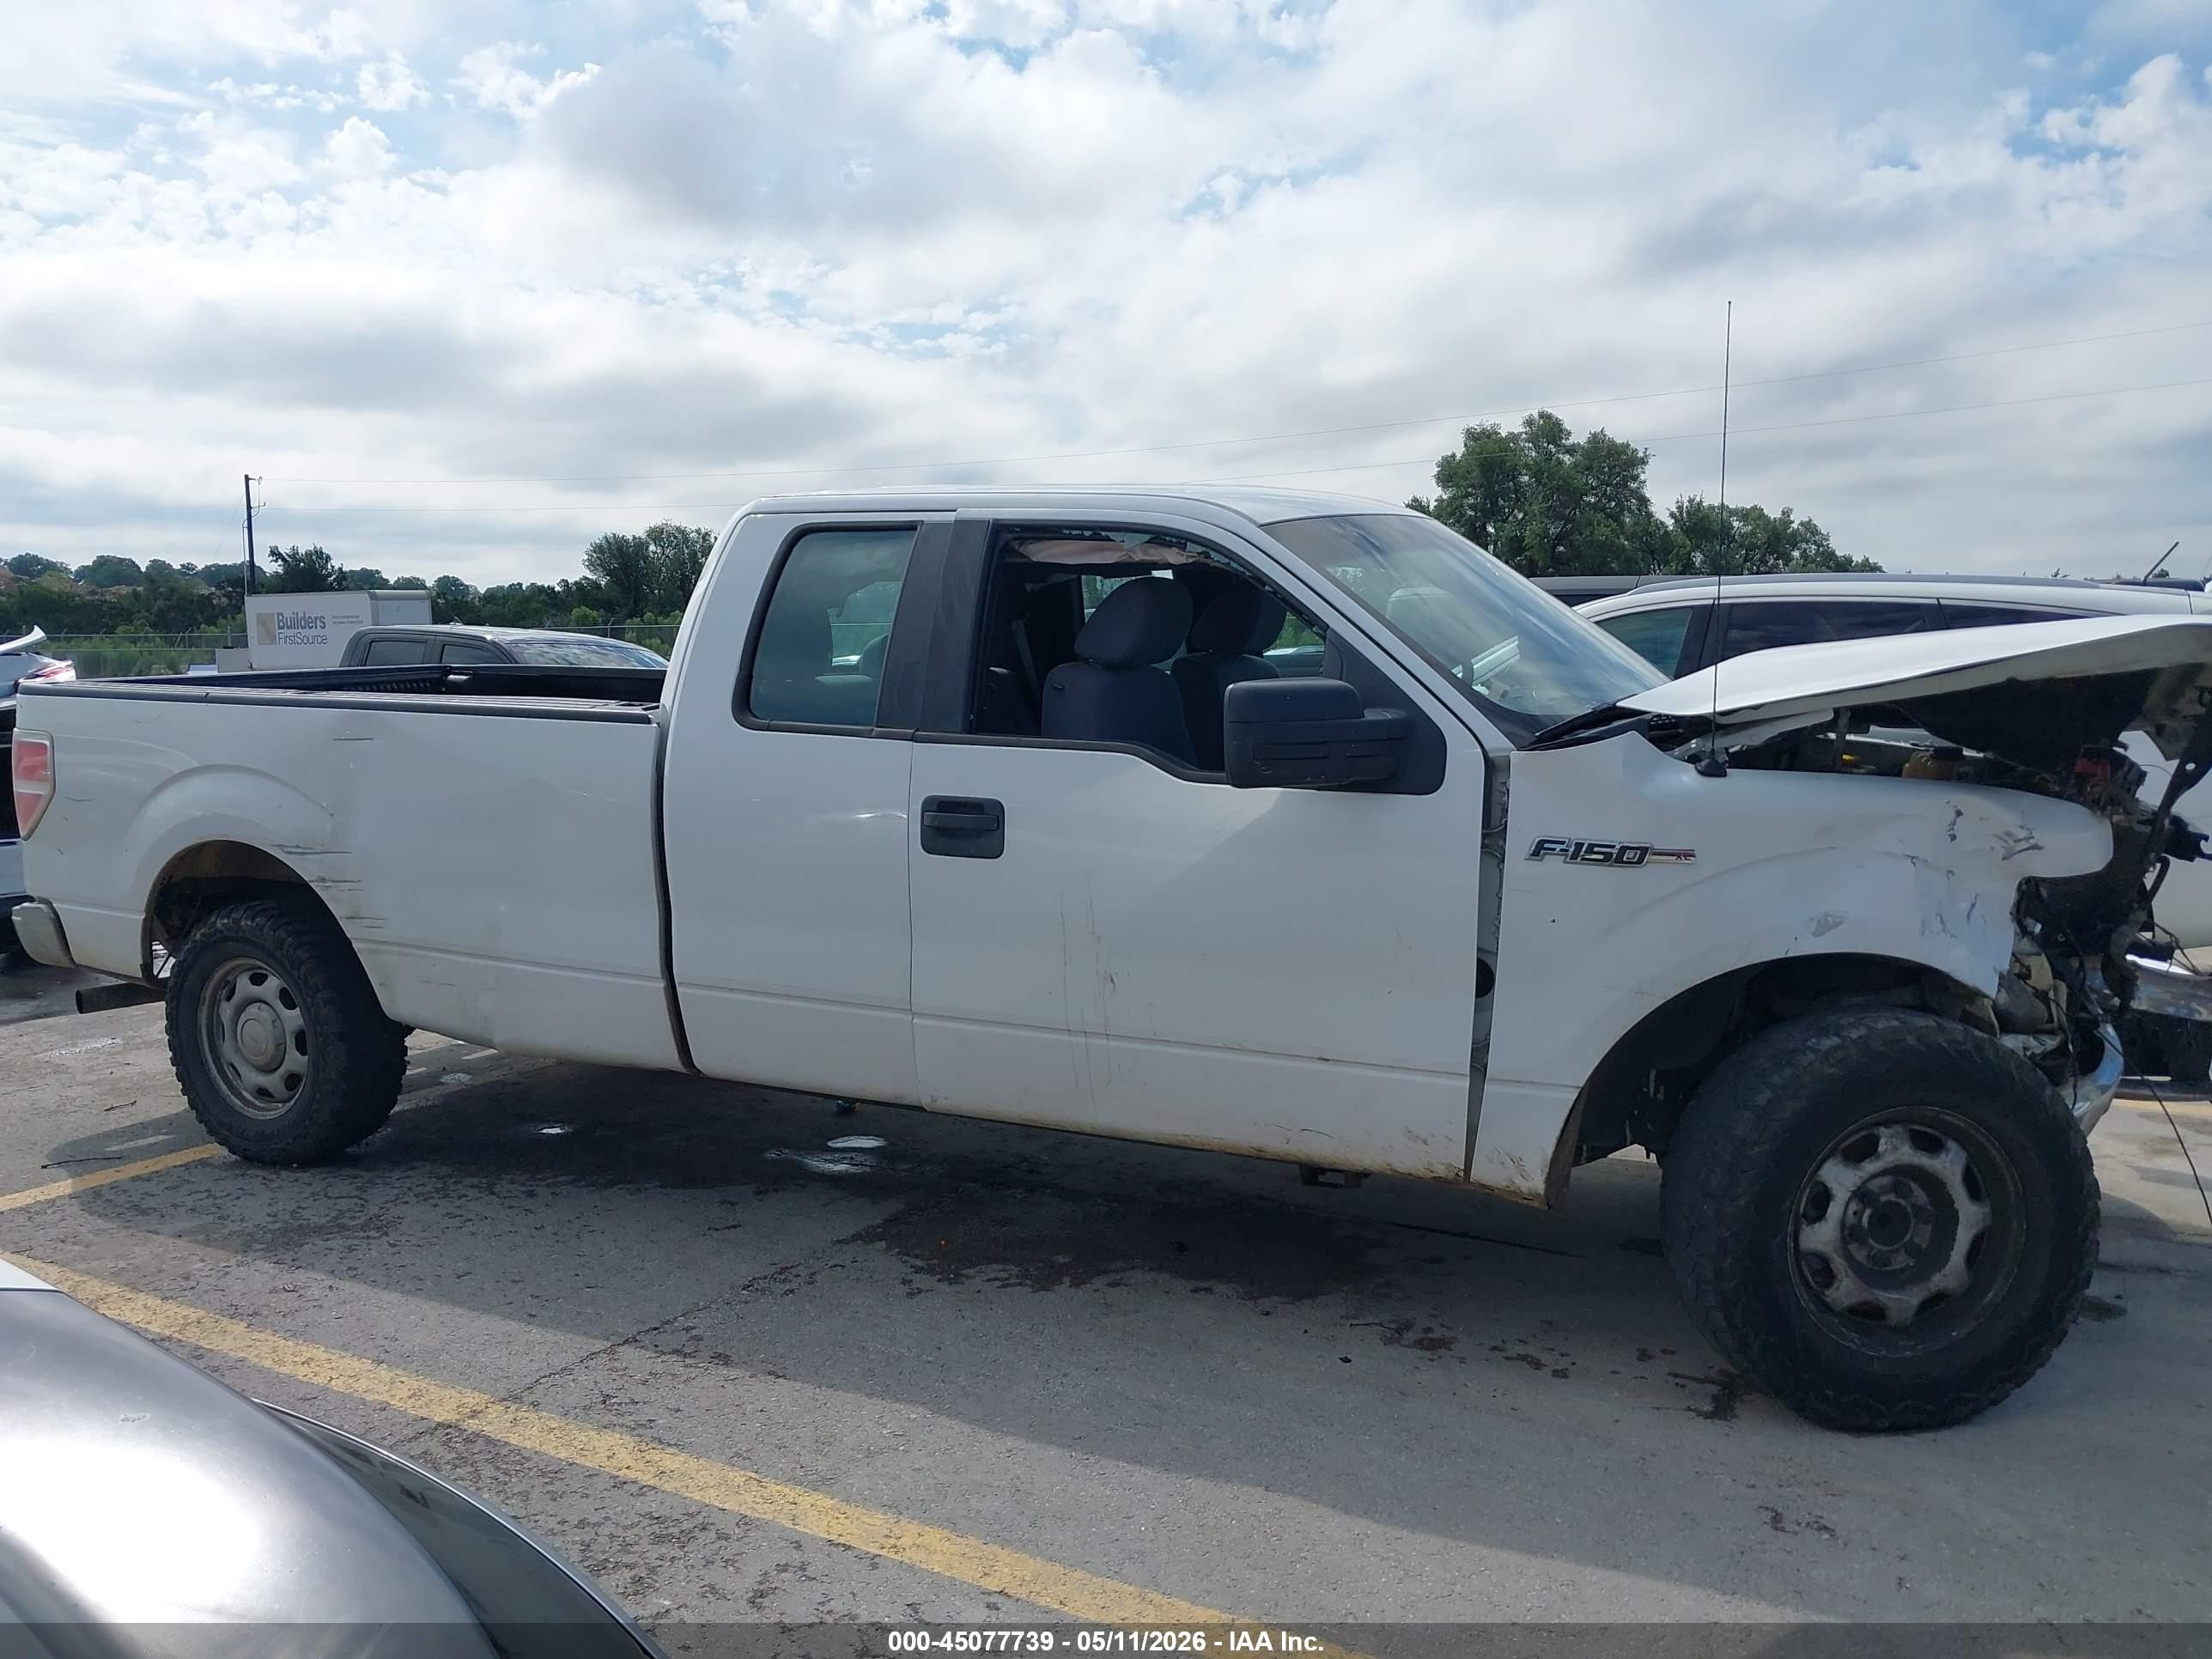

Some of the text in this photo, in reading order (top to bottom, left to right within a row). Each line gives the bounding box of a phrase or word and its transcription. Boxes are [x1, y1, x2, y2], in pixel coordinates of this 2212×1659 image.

[276, 611, 326, 629] Builders
[277, 632, 328, 645] FirstSource
[1528, 836, 1652, 867] F-150
